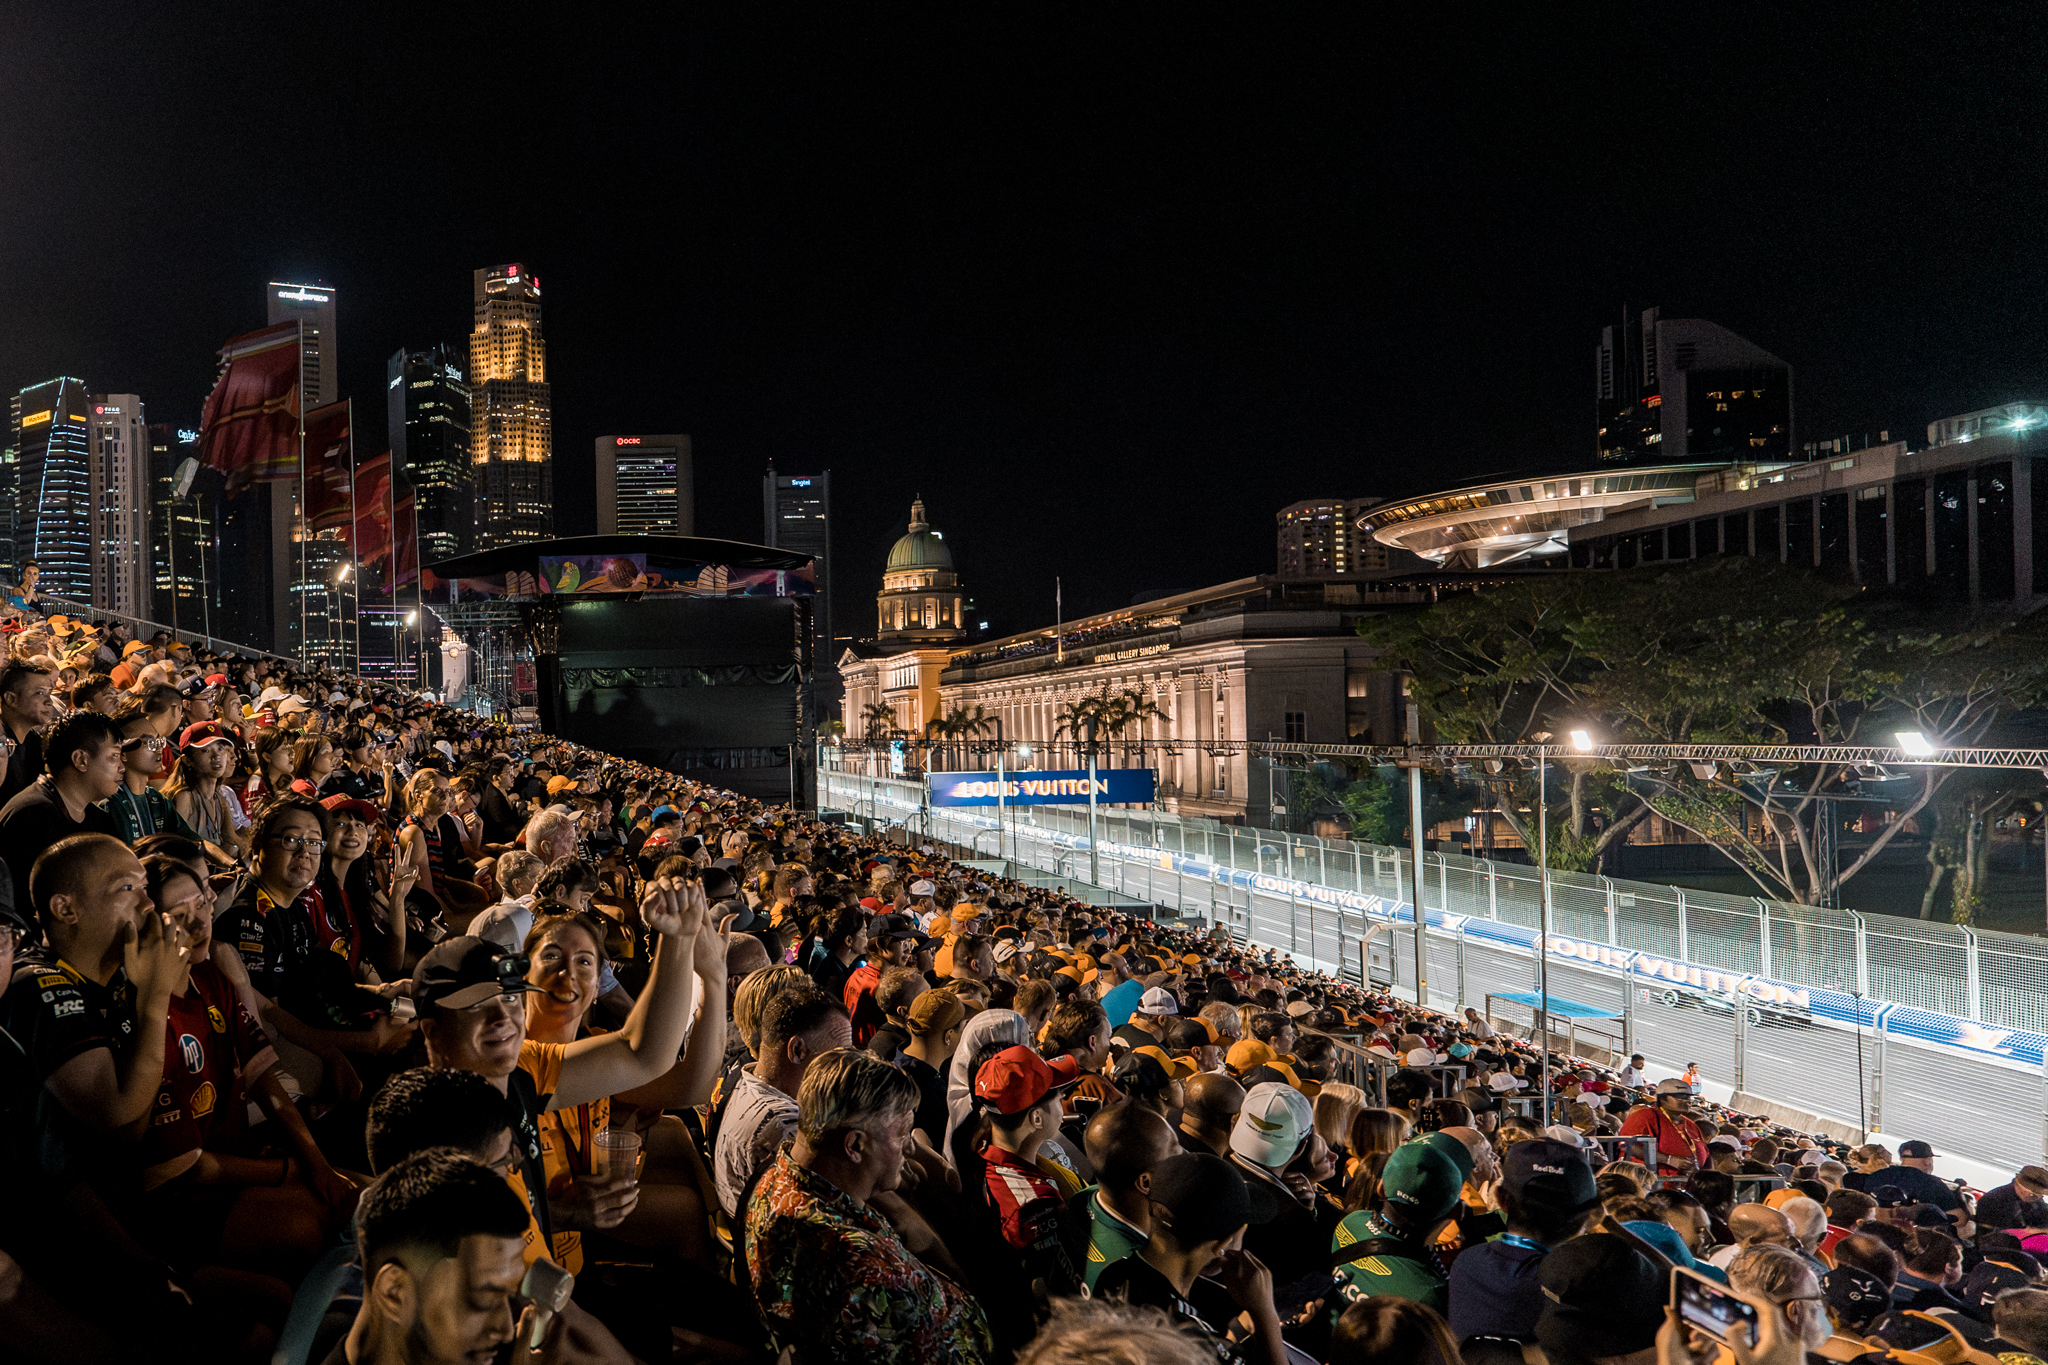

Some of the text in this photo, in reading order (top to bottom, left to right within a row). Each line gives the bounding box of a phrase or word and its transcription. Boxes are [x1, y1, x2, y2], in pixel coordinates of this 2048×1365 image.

[791, 479, 811, 487] Singtel
[1094, 652, 1117, 664] NATIONAL
[1116, 648, 1139, 660] GALLERY
[960, 778, 1109, 798] LOUIS VUITTON
[1096, 840, 1121, 854] OUIS
[1256, 875, 1383, 915] LOUIS VUITTON
[1637, 955, 1811, 1009] VUITTON
[53, 999, 86, 1017] HRC
[181, 1036, 201, 1073] hp
[1532, 1163, 1549, 1172] Red
[1364, 1220, 1381, 1236] BOSS
